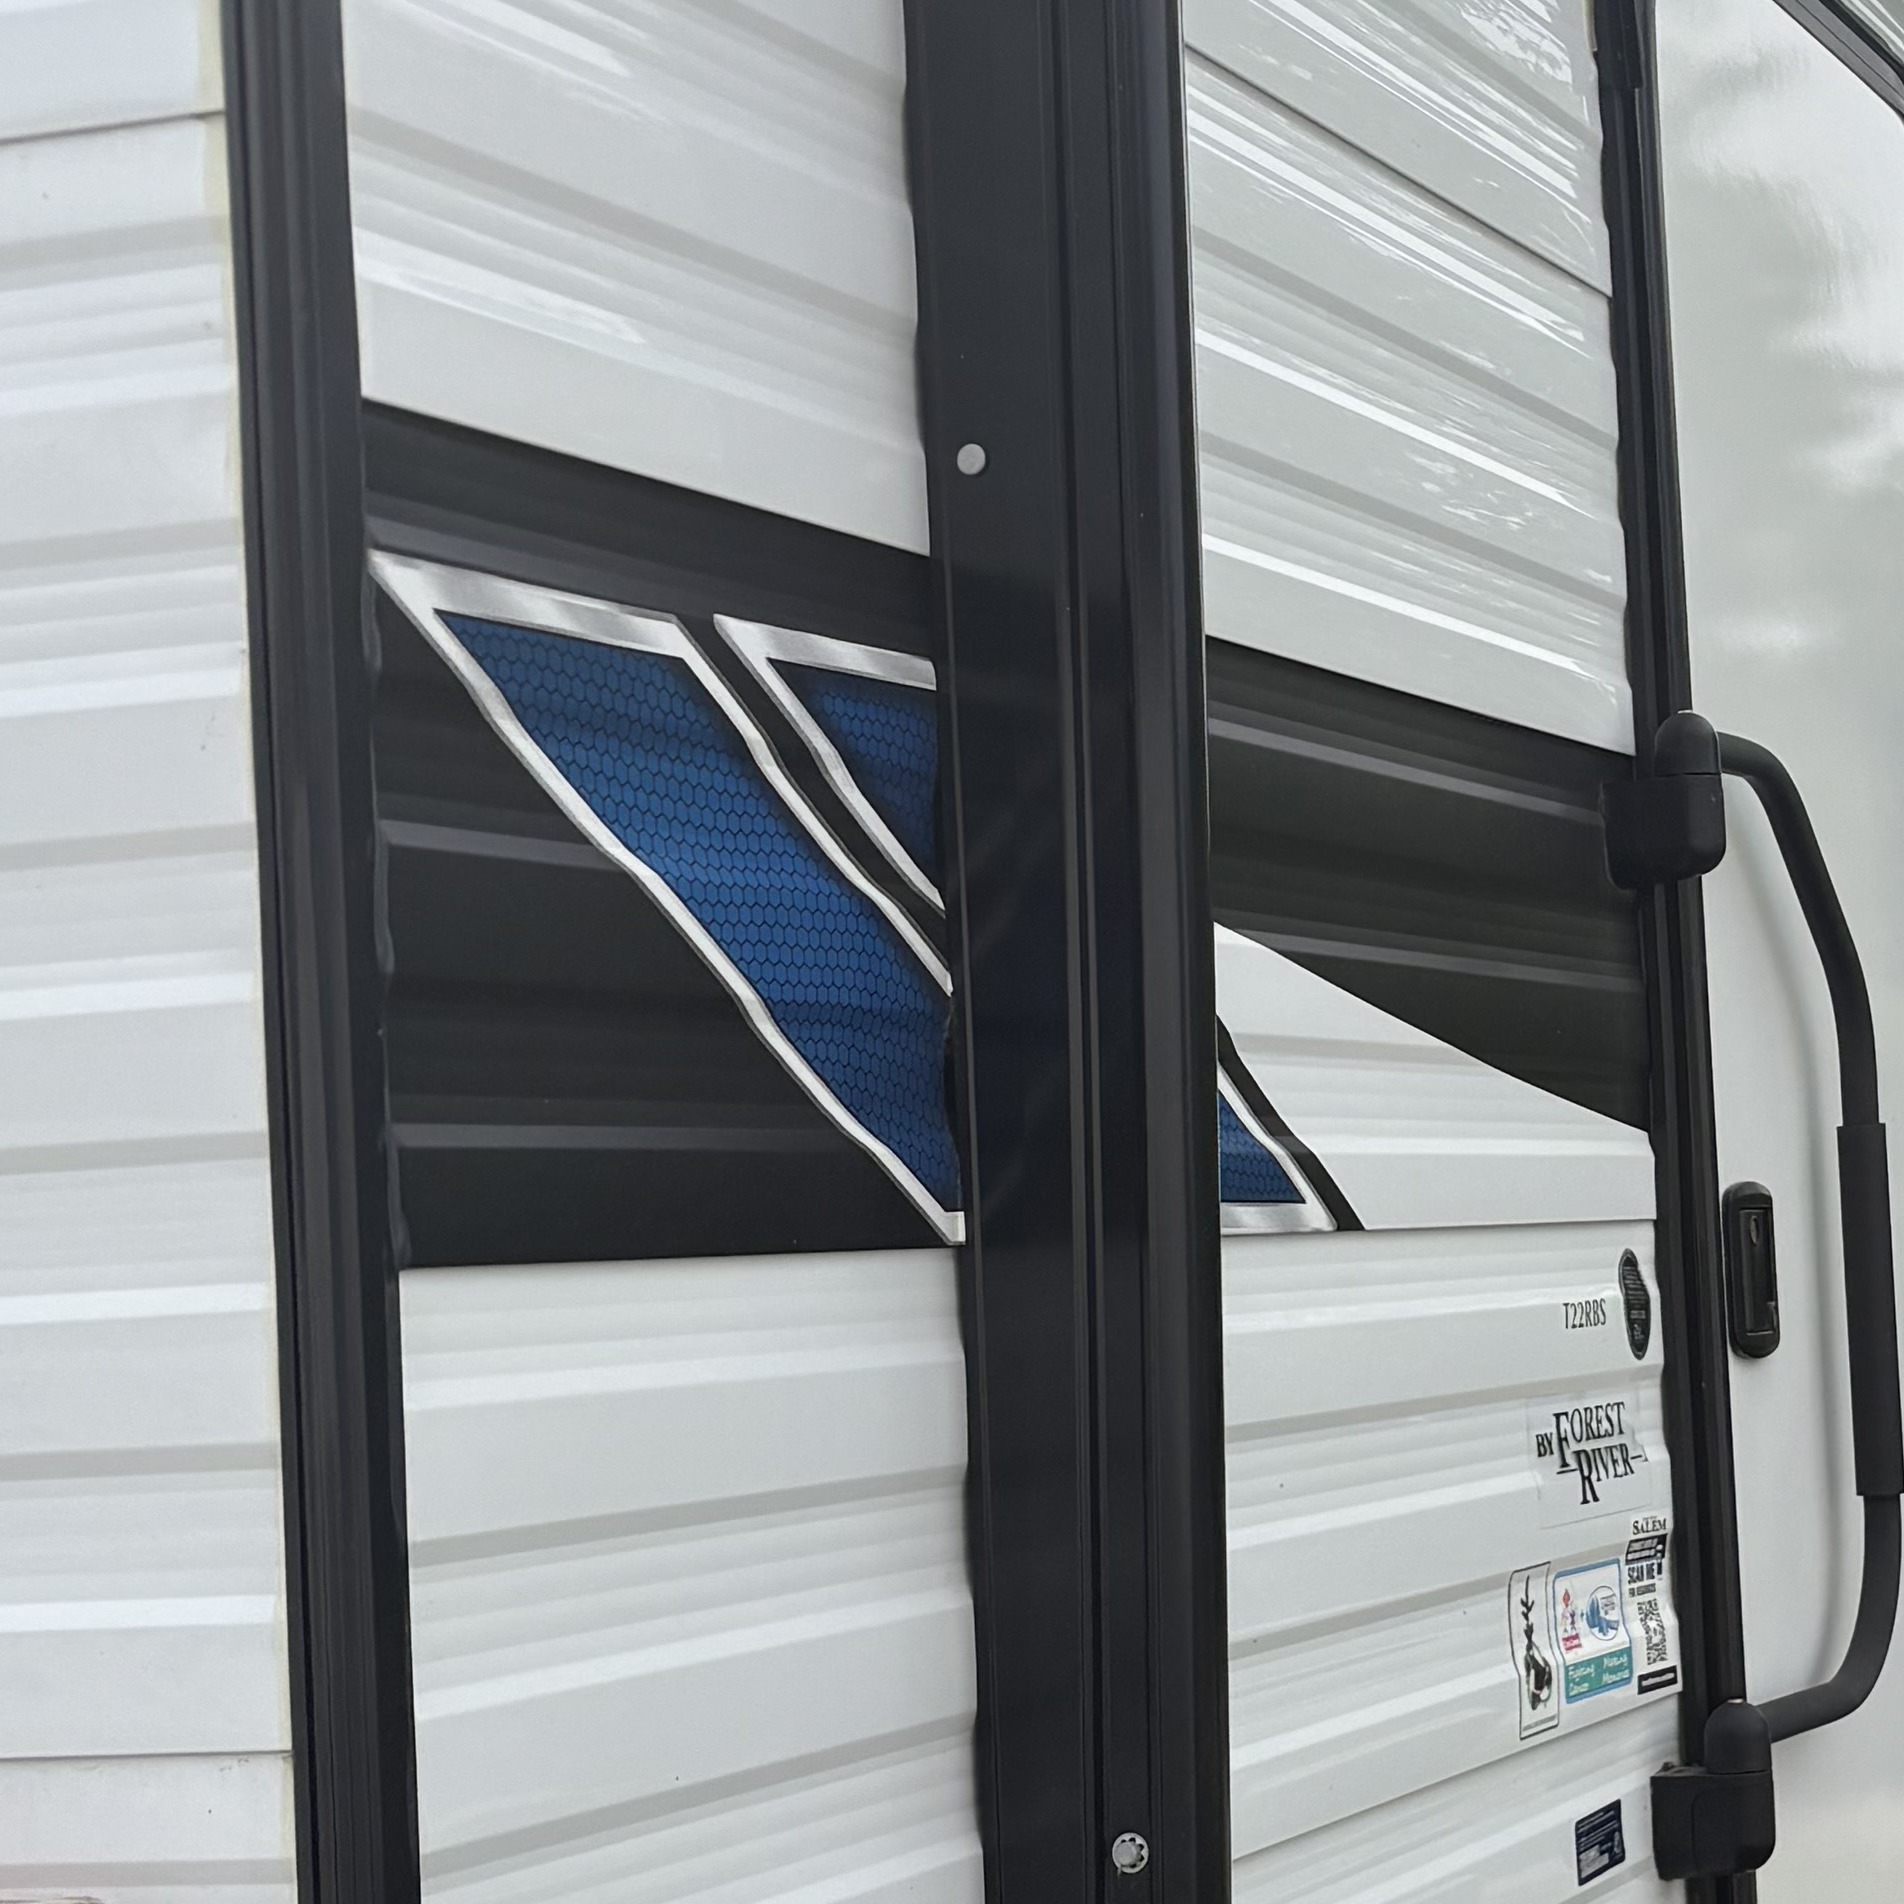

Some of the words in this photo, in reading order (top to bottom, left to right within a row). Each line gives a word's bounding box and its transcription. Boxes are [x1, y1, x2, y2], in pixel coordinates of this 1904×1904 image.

[1562, 1298, 1607, 1329] T22RBS
[1535, 1432, 1554, 1457] BY
[1553, 1401, 1626, 1468] FOREST
[1571, 1443, 1635, 1505] RIVER
[1632, 1518, 1667, 1535] SALEM
